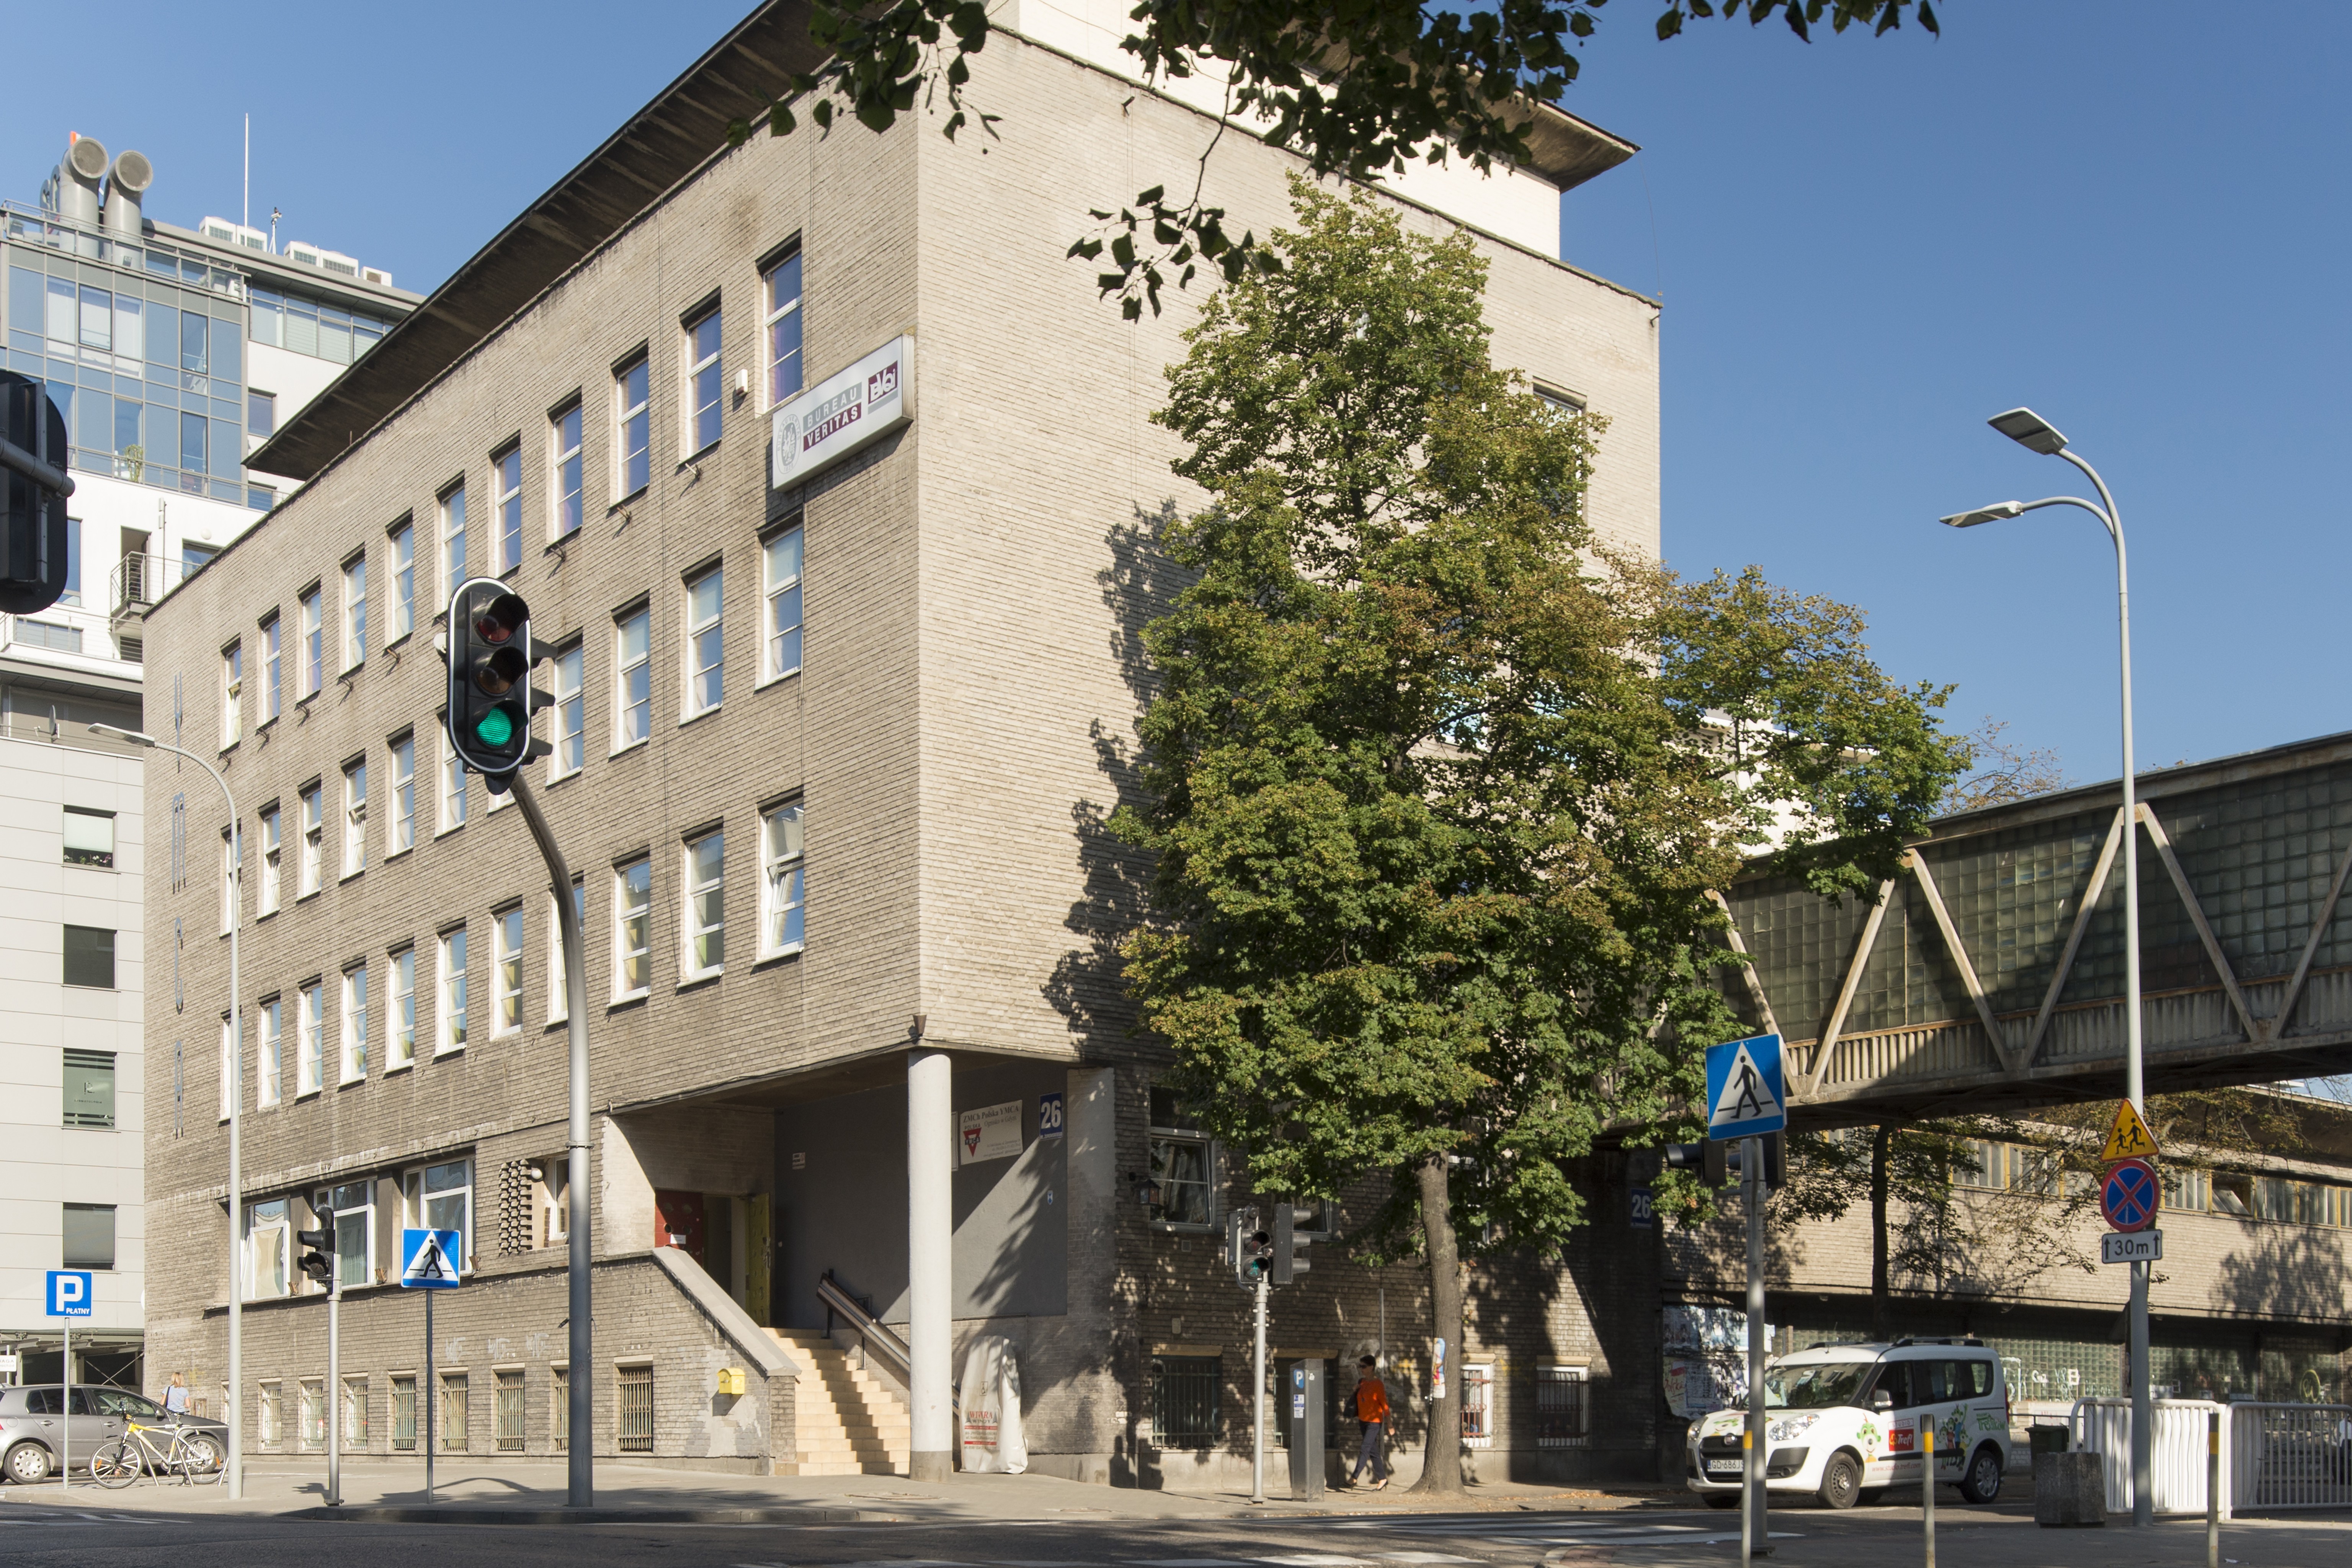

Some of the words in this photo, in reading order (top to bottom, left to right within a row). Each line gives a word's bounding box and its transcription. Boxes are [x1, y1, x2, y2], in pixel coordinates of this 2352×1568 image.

[807, 387, 857, 428] BUREAU
[807, 406, 858, 447] VERITAS
[982, 1110, 998, 1119] Polska
[1000, 1105, 1019, 1115] YMCA
[1041, 1100, 1061, 1129] 26
[1632, 1194, 1651, 1218] 26
[56, 1275, 83, 1312] P
[1296, 1371, 1303, 1385] P
[969, 1410, 993, 1419] WIWRA
[1897, 1434, 1913, 1446] Trefl
[1712, 1460, 1722, 1469] GD
